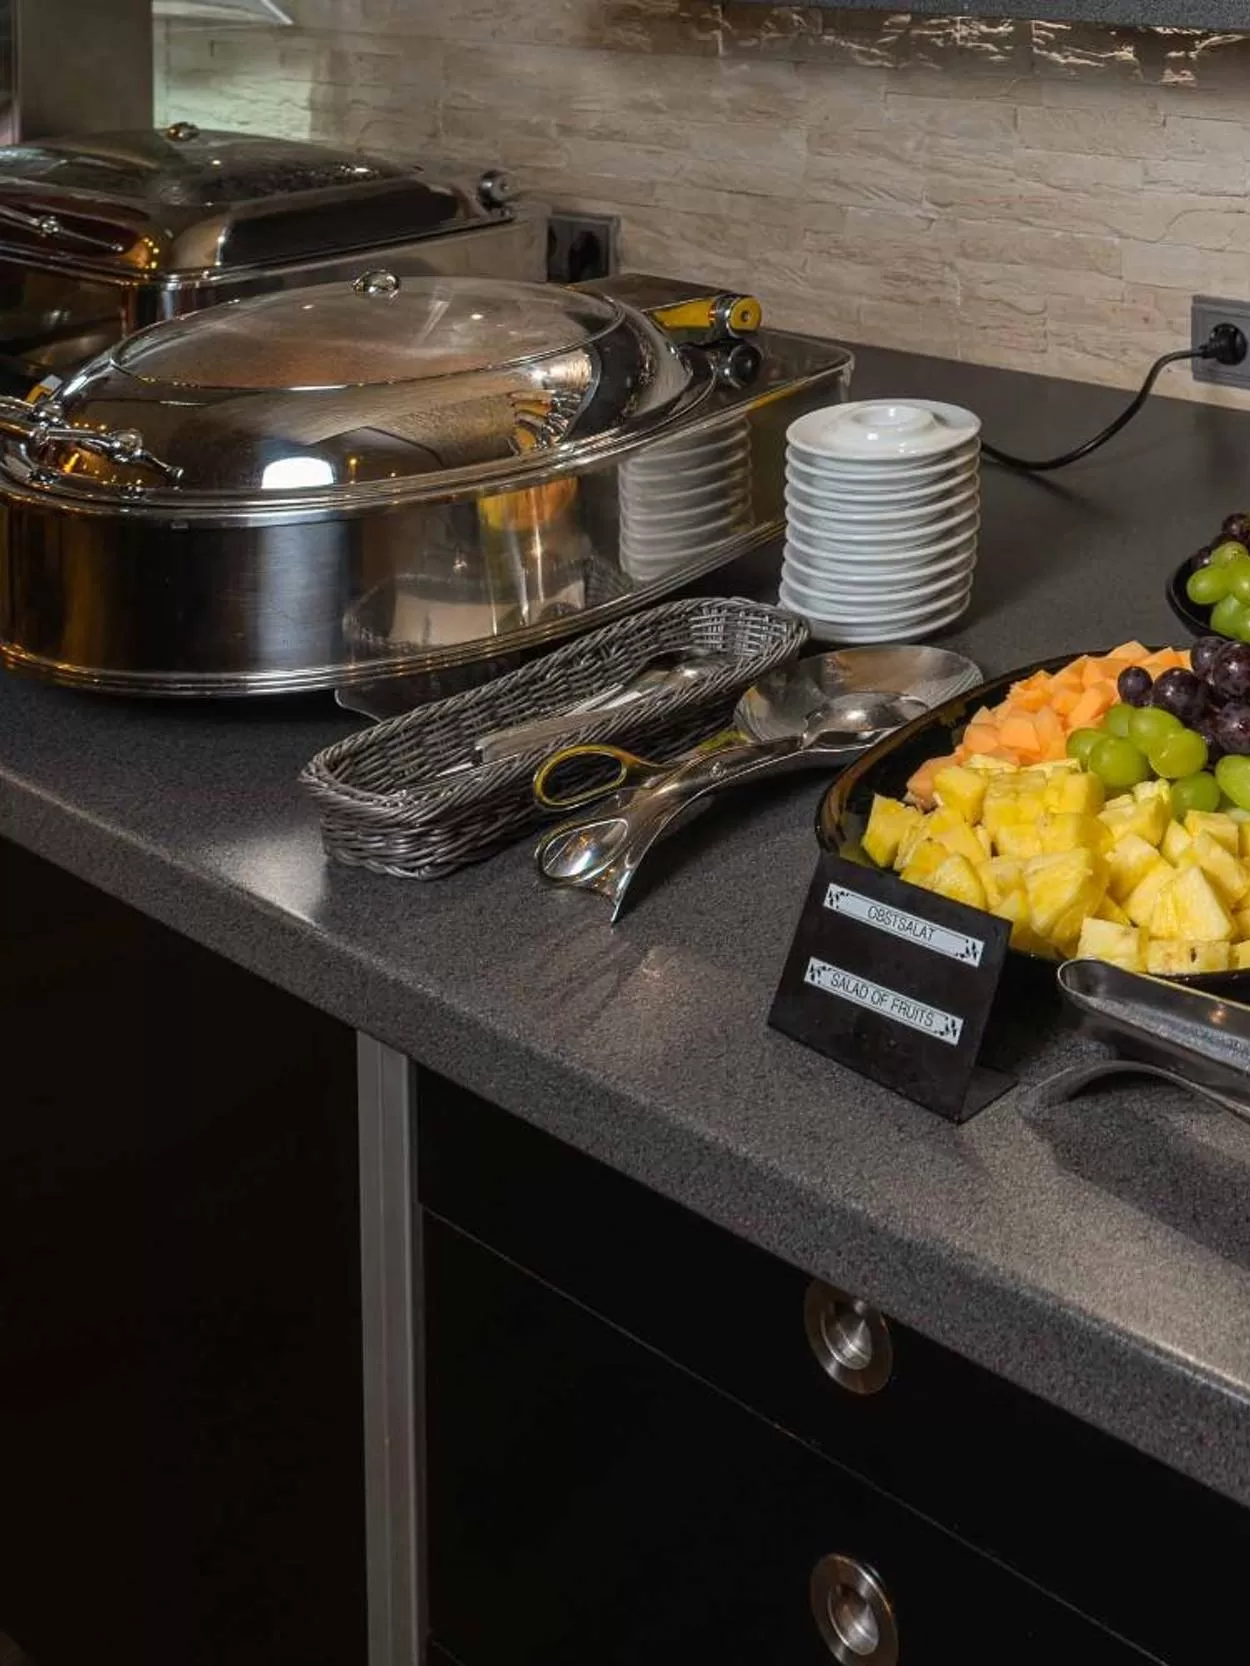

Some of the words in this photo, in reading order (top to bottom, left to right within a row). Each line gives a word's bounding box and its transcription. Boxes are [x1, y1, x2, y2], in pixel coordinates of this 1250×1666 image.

[867, 905, 935, 942] OBSTSALAT
[830, 973, 869, 1000] SALAD
[871, 988, 891, 1006] OF
[890, 999, 935, 1027] FRUITS
